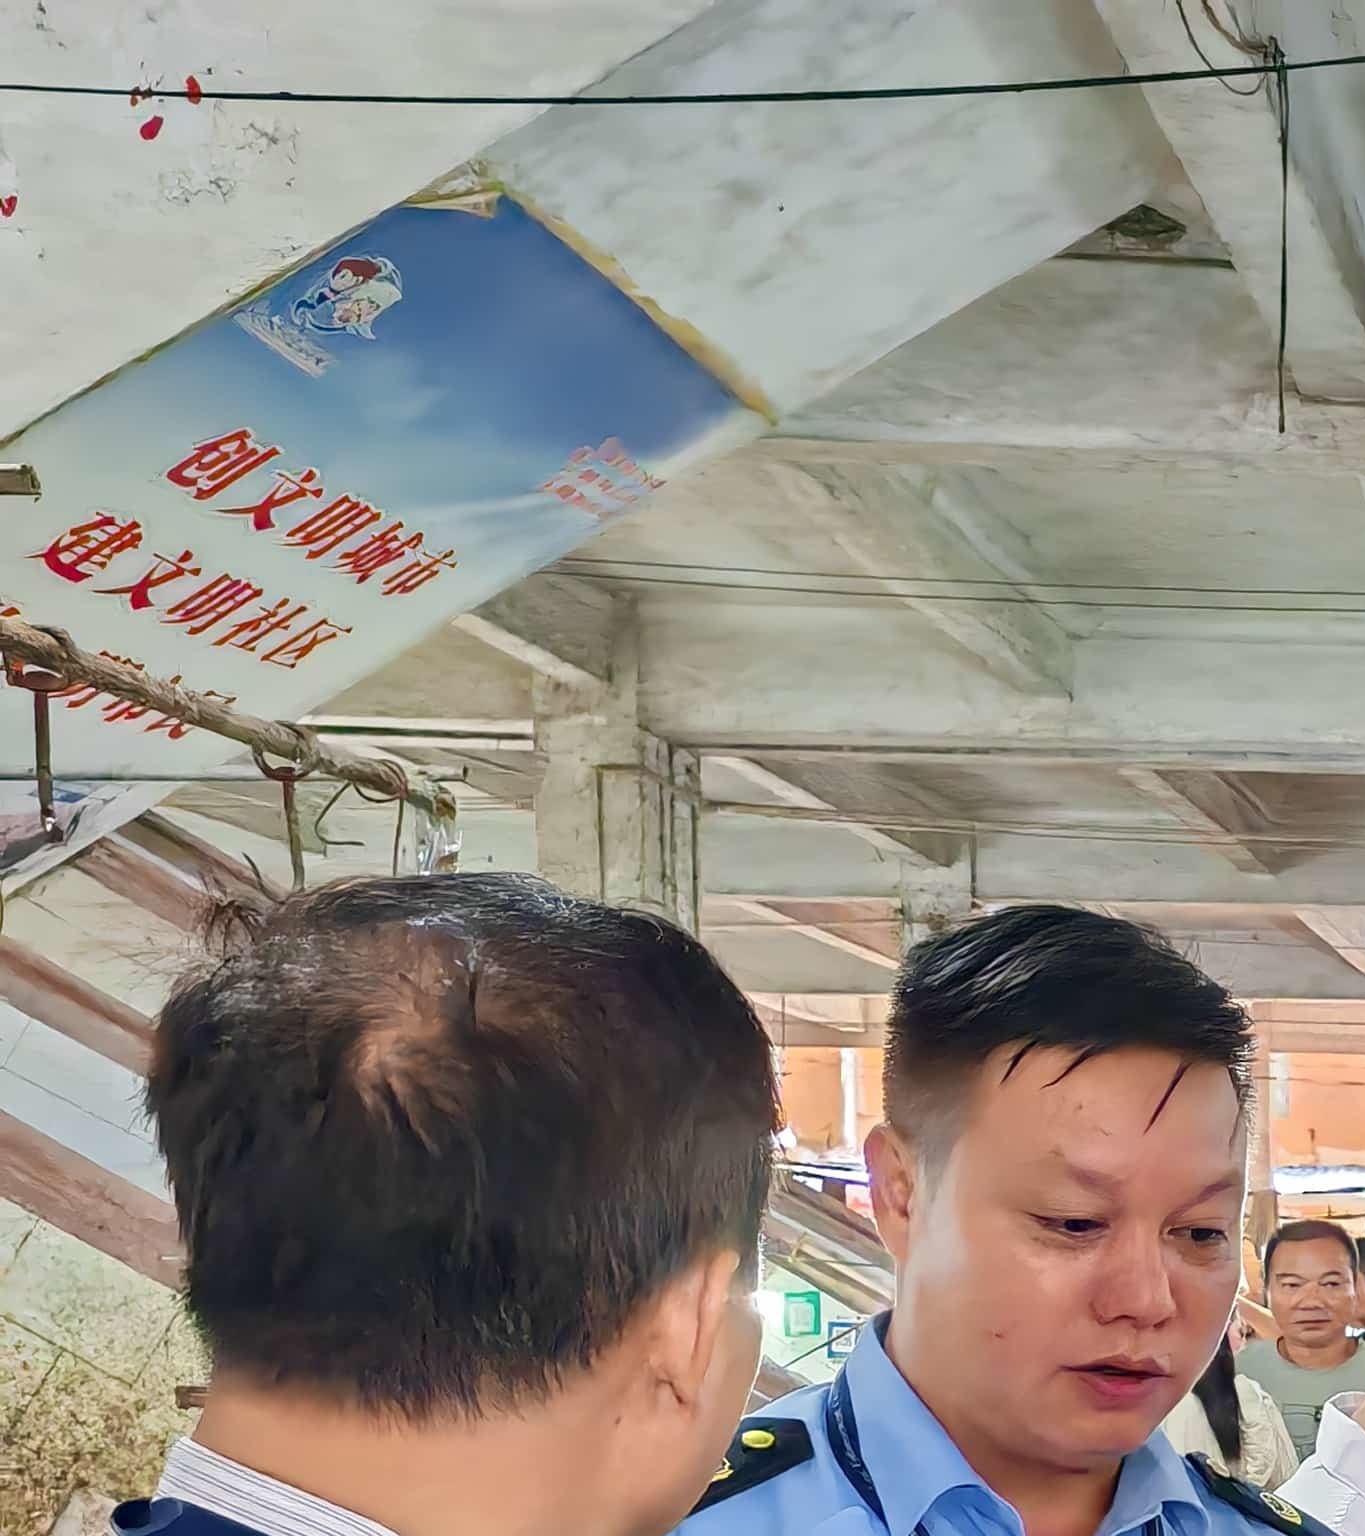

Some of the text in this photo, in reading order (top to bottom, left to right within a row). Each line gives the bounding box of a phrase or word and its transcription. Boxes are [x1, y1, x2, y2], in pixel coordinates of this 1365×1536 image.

[24, 511, 353, 669] 建文明社区
[166, 429, 457, 597] 创文明城市
